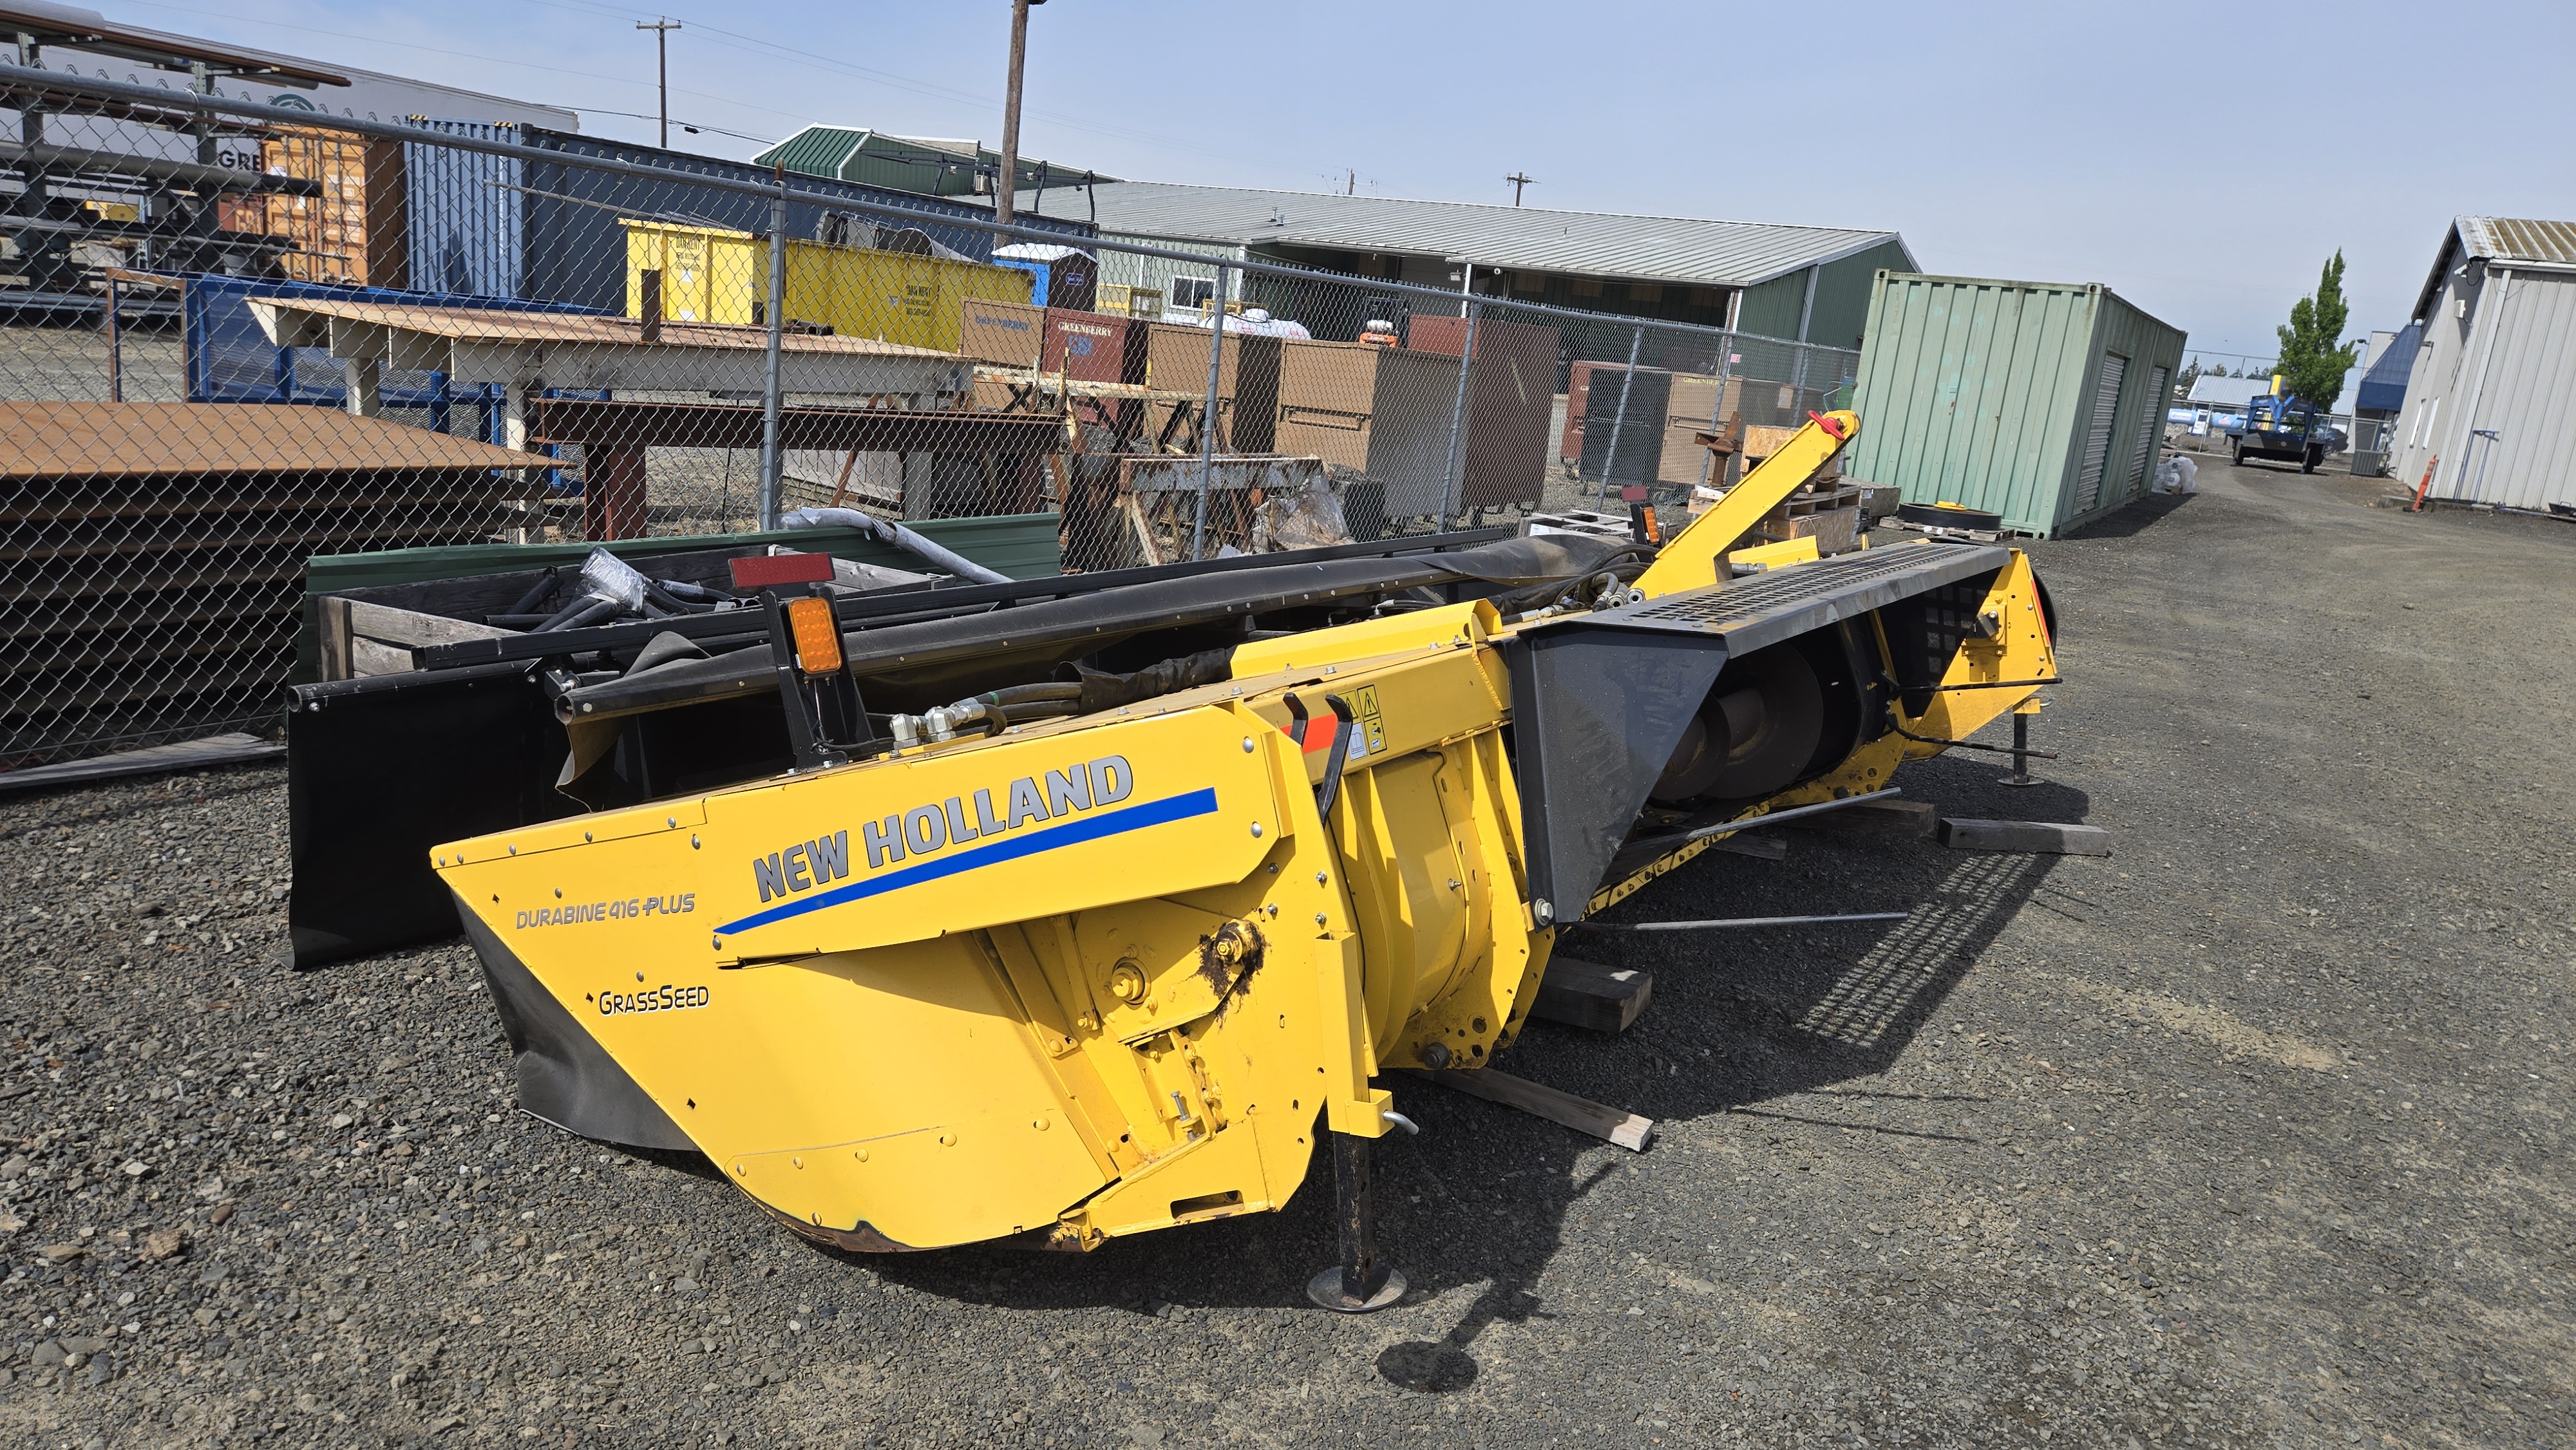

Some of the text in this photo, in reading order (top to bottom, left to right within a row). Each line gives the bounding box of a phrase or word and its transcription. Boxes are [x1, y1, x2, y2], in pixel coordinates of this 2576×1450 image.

[220, 150, 261, 171] GRE
[975, 315, 1030, 331] GREENBERRY
[1058, 321, 1113, 336] GREENBERRY
[753, 755, 1133, 903] NEW HOLLAND
[516, 902, 607, 929] DURABINE
[609, 899, 639, 919] 416
